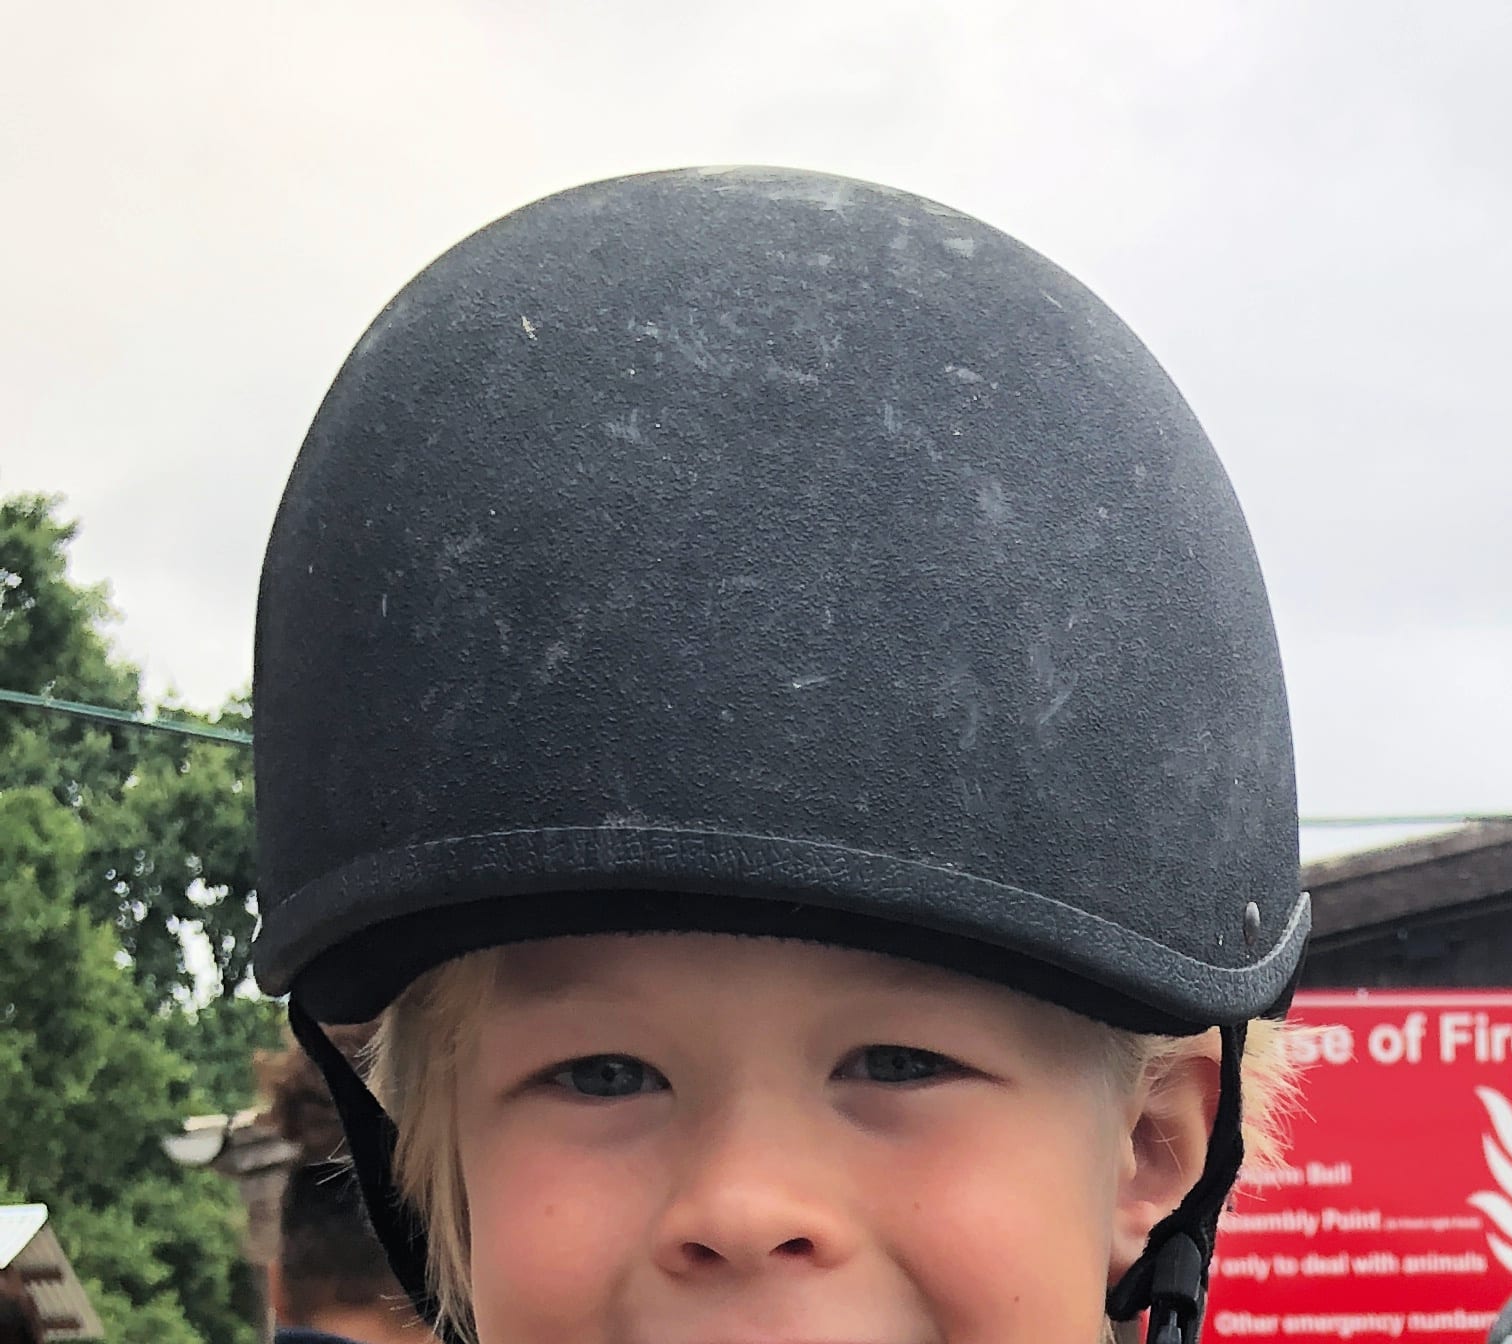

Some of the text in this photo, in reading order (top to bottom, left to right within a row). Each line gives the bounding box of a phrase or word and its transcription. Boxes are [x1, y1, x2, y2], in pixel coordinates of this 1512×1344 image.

[1290, 1024, 1354, 1064] se
[1368, 1012, 1427, 1064] of
[1217, 1208, 1318, 1237] ssembly
[1321, 1207, 1381, 1231] Point
[1221, 1252, 1271, 1282] only
[1273, 1254, 1298, 1275] to
[1301, 1252, 1348, 1275] deal
[1352, 1251, 1398, 1275] with
[1402, 1250, 1487, 1275] animals
[1214, 1308, 1500, 1338] Other emergency number
